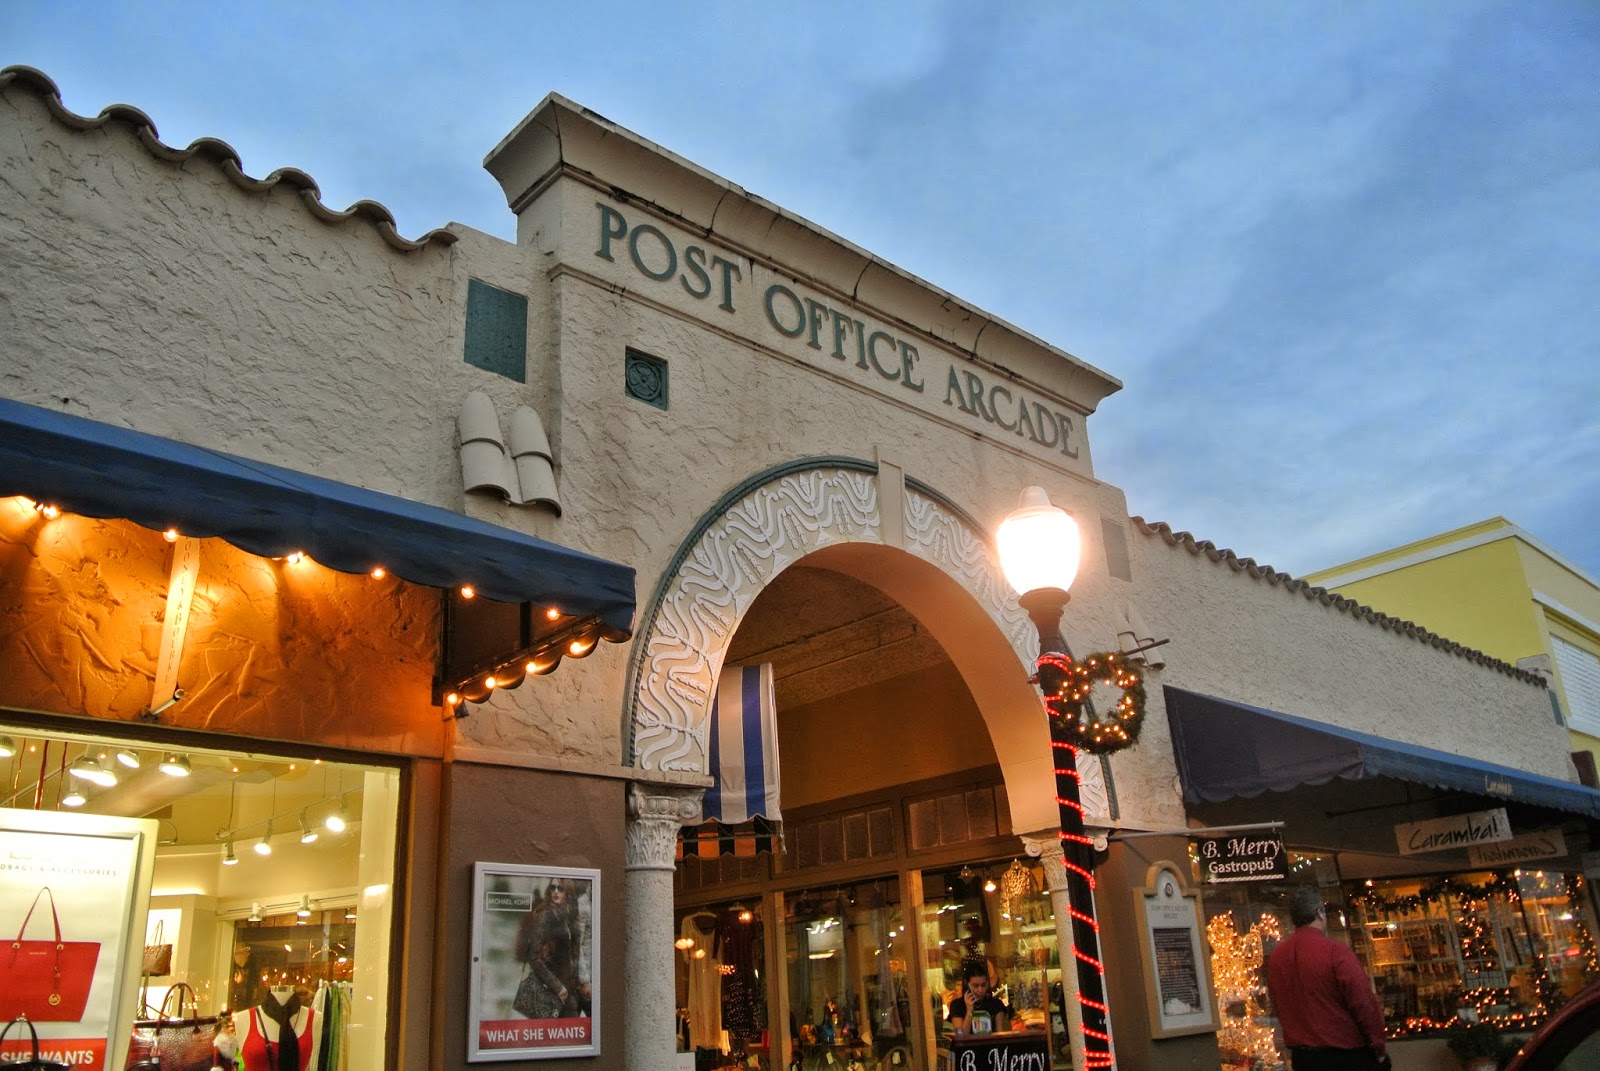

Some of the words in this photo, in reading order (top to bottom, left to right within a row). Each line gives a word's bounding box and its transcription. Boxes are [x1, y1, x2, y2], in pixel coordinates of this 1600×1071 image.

[595, 201, 741, 313] POST
[763, 284, 924, 393] OFFICE
[943, 364, 1079, 459] ARCADE
[1408, 815, 1499, 850] Caramba!
[1202, 840, 1221, 858] B.
[1227, 837, 1280, 860] Merry
[1208, 857, 1274, 874] Gastropub
[486, 1029, 519, 1042] WHAT
[522, 1028, 544, 1041] SHE
[547, 1026, 586, 1040] WANTS
[38, 1049, 94, 1066] WANTS
